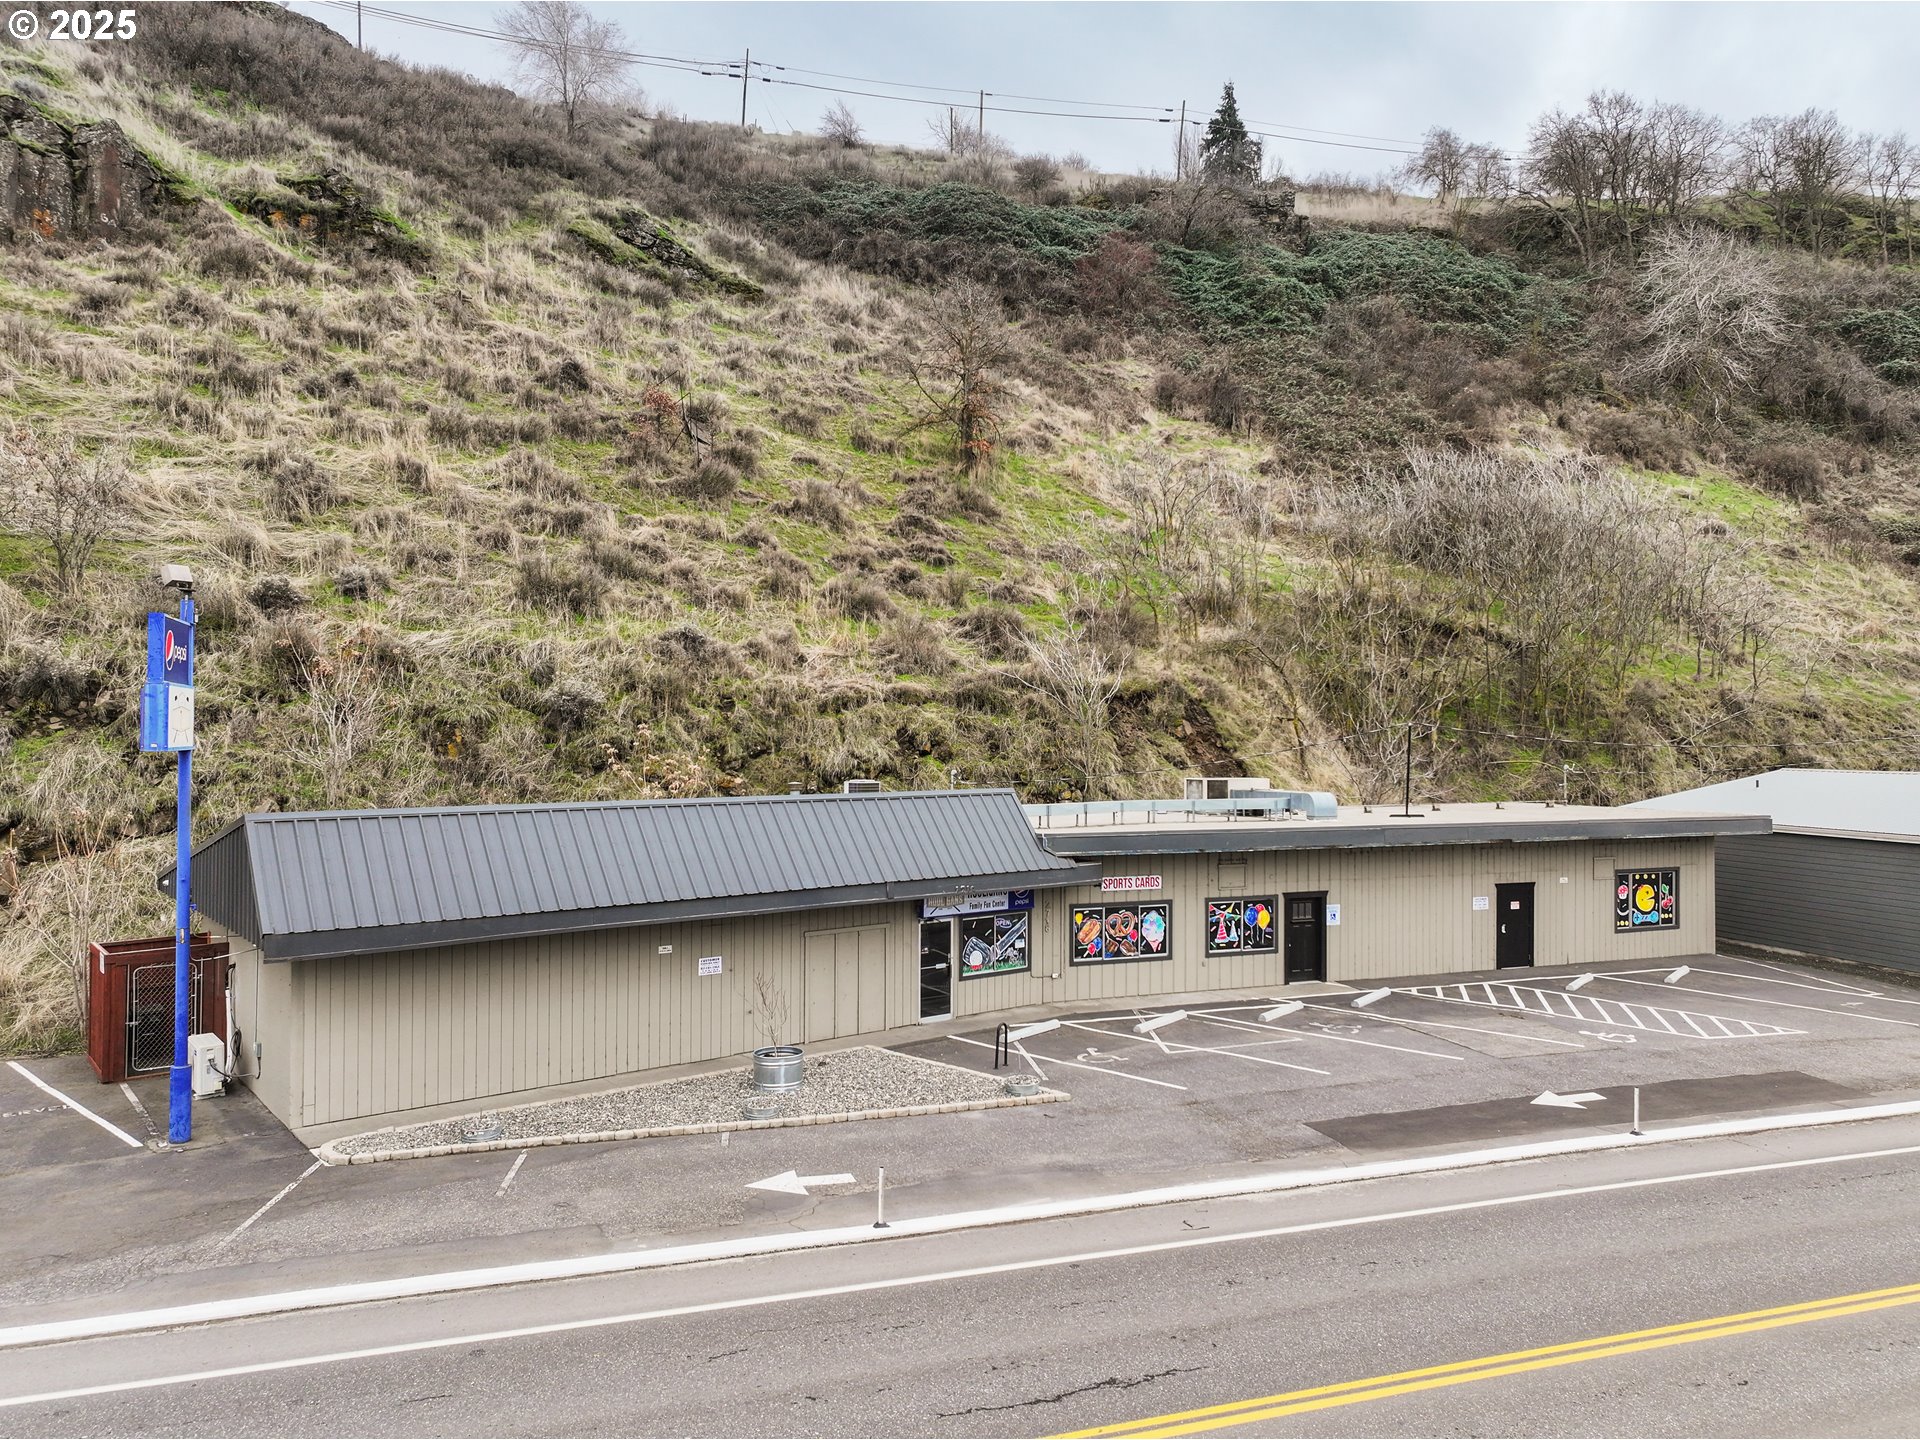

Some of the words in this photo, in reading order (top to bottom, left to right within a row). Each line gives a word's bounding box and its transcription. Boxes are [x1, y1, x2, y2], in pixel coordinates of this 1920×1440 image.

[174, 645, 186, 662] pepsi
[1103, 878, 1133, 889] SPORTS
[1135, 876, 1160, 888] CARDS
[969, 902, 983, 910] Family
[1014, 898, 1029, 906] pepsi
[996, 919, 1011, 927] OPEN
